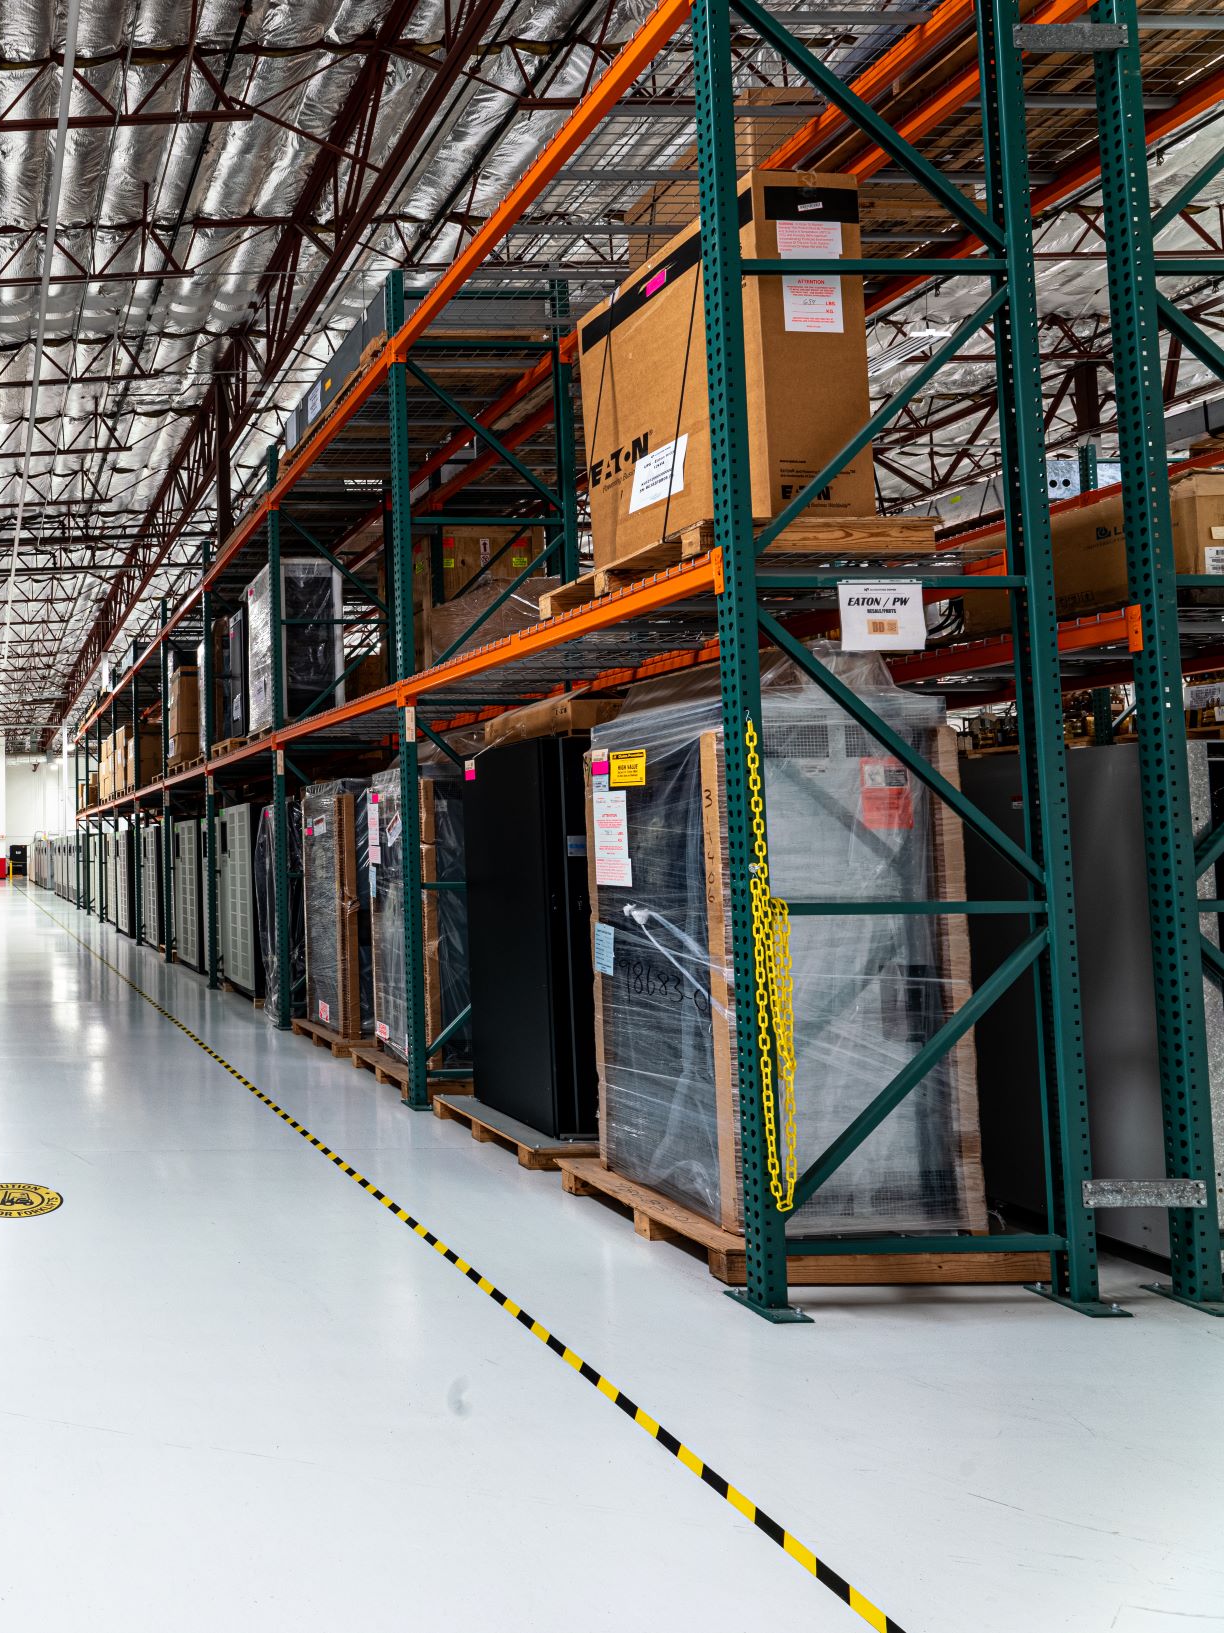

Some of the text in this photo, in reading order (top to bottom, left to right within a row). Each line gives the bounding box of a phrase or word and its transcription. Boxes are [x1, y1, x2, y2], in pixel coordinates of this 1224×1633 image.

[590, 431, 649, 489] EATON
[847, 597, 910, 608] EATON / PW
